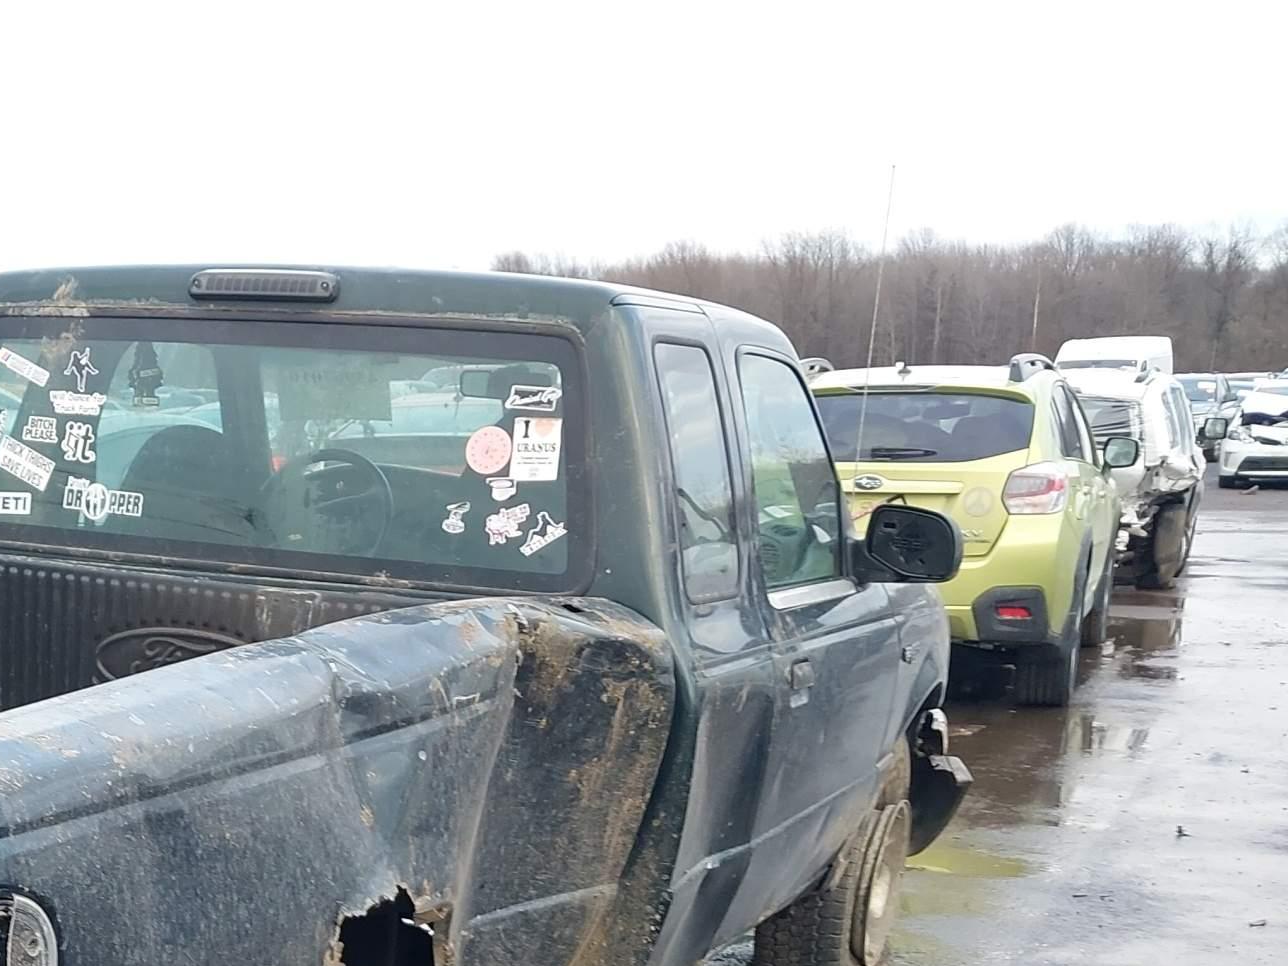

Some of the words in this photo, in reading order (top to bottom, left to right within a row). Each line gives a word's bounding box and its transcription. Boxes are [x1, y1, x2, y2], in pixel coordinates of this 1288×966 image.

[30, 417, 54, 430] BITCH
[522, 419, 531, 438] I
[516, 442, 557, 453] URANUS
[1, 455, 22, 475] SAVE
[20, 467, 44, 487] LIVES
